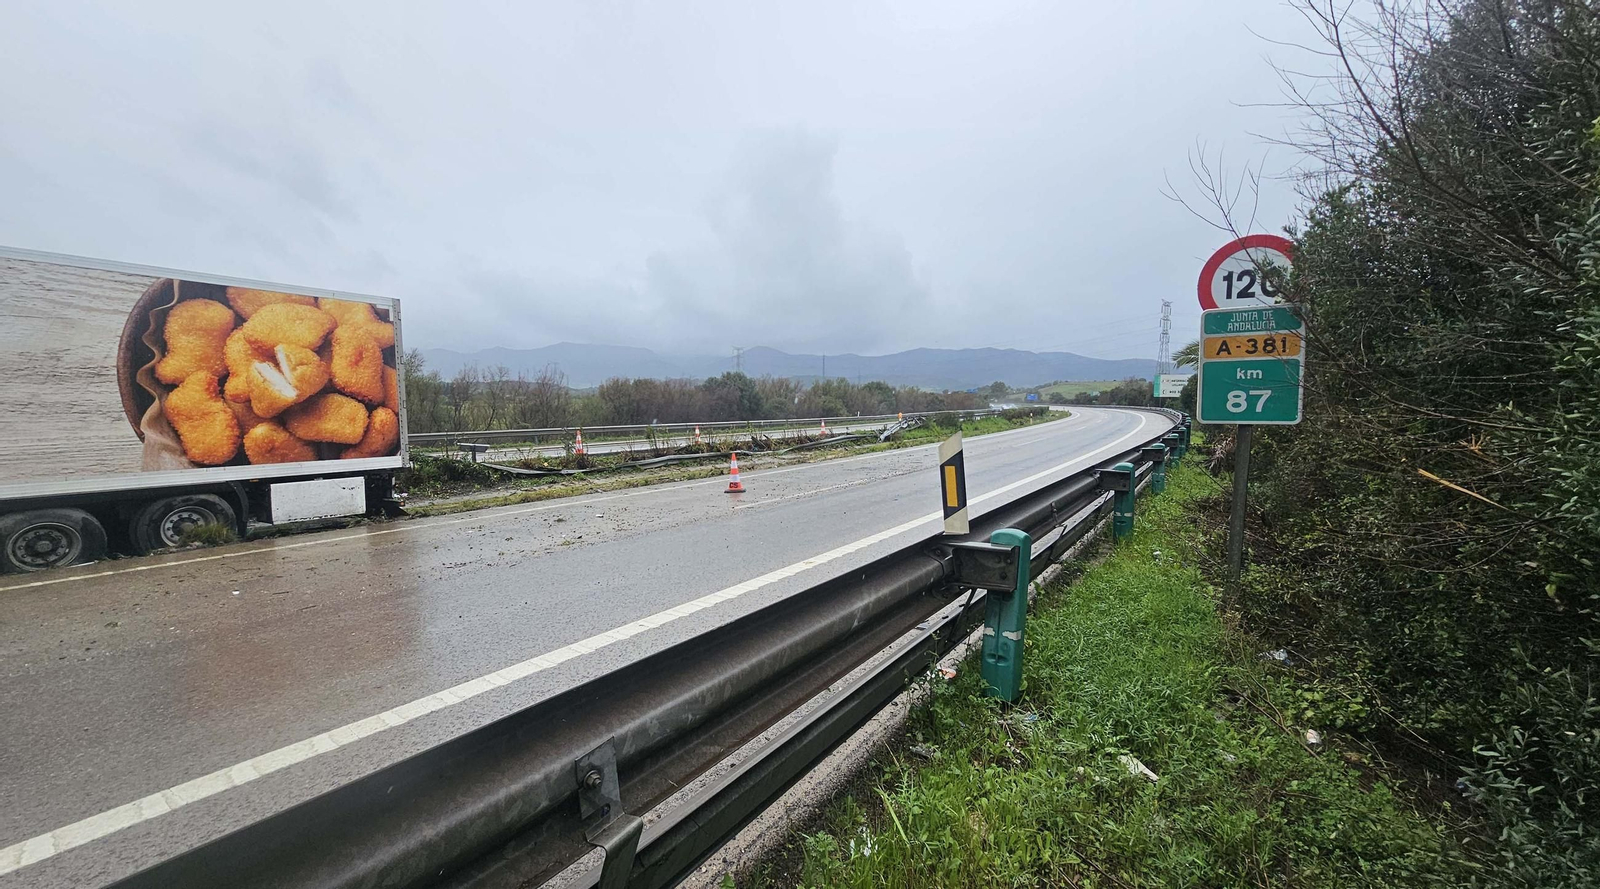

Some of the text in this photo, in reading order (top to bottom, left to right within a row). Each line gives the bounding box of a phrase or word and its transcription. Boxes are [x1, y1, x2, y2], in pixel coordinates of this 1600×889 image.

[1230, 310, 1274, 322] JUNTA DE
[1216, 337, 1287, 355] A-381
[1236, 367, 1262, 379] km
[1226, 389, 1272, 413] 87
